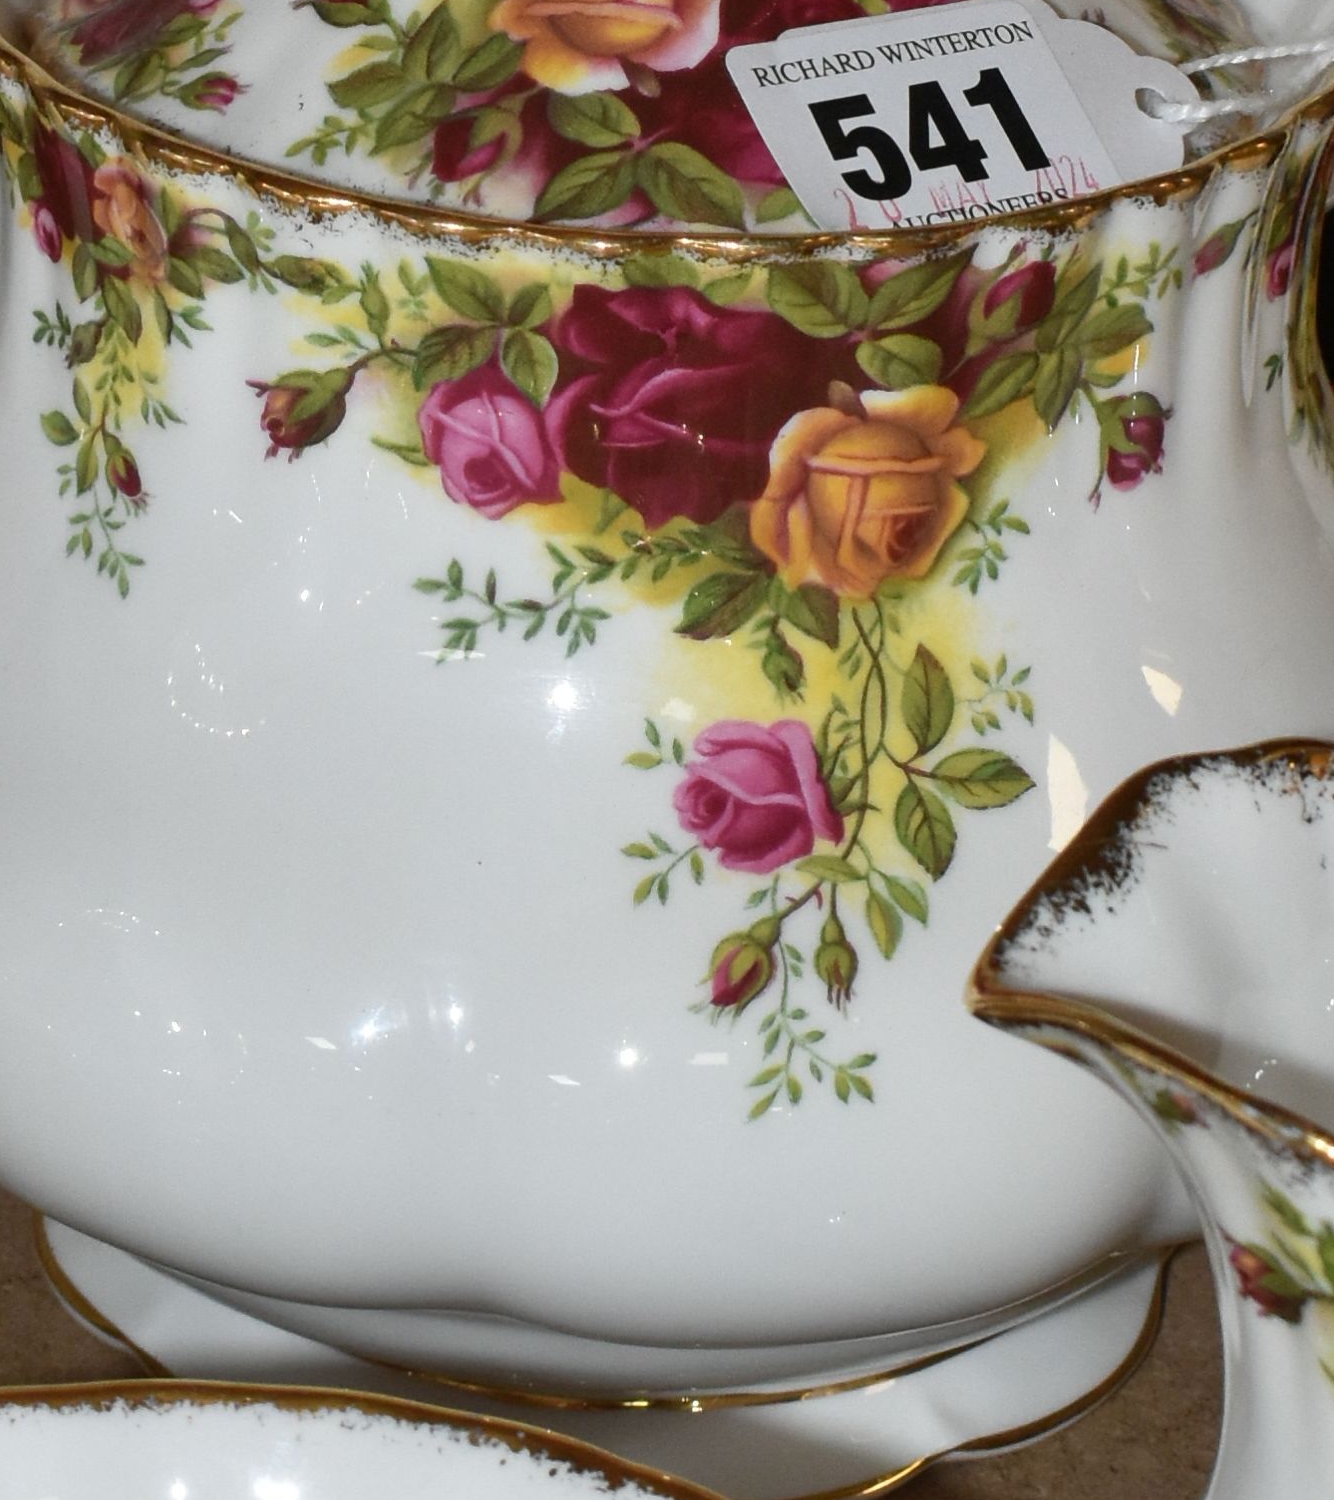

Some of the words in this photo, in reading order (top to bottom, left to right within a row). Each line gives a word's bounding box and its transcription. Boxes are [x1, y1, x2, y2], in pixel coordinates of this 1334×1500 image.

[750, 49, 876, 88] RICHARD
[877, 19, 1036, 64] WINTERTON
[807, 66, 1052, 202] 541
